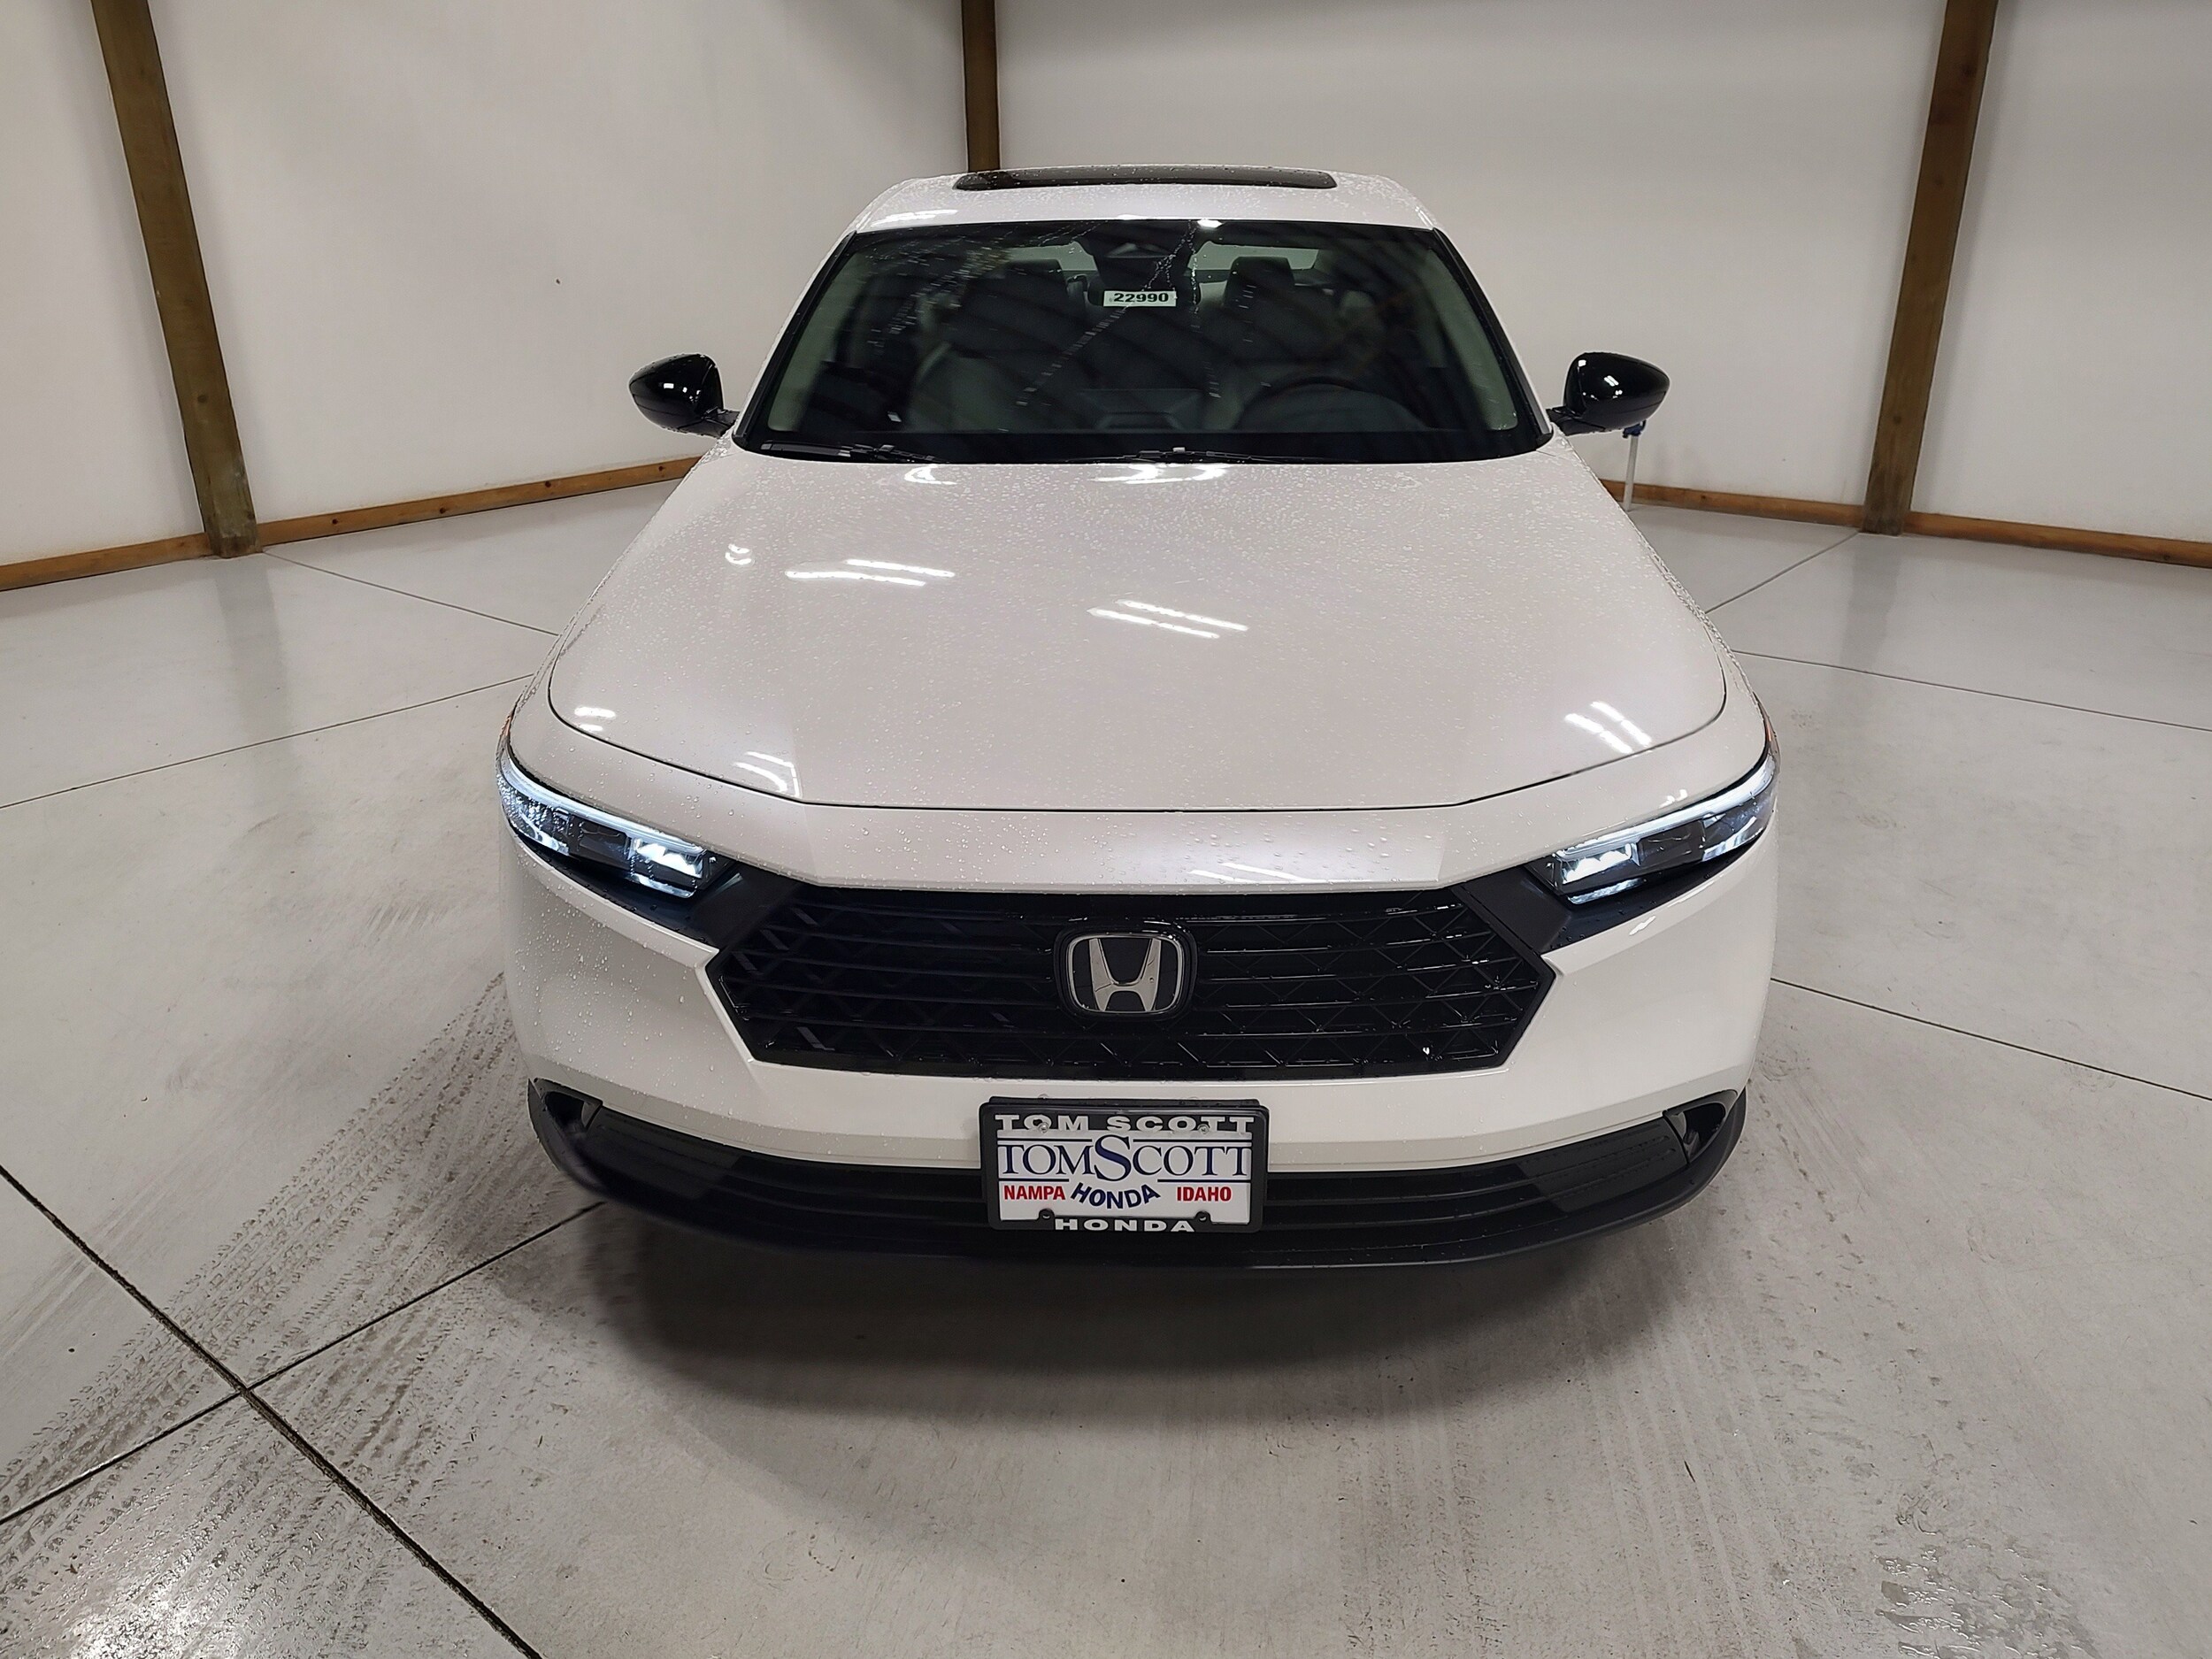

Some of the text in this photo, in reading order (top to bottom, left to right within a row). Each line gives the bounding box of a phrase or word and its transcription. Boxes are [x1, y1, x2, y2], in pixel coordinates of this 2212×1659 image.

[1113, 292, 1169, 303] 22990
[995, 1115, 1255, 1133] TOM SCOTT
[1003, 1186, 1065, 1201] NAMPA
[1071, 1183, 1161, 1210] HONDA
[1177, 1187, 1233, 1202] IDAHO
[1055, 1218, 1194, 1233] HONDA
